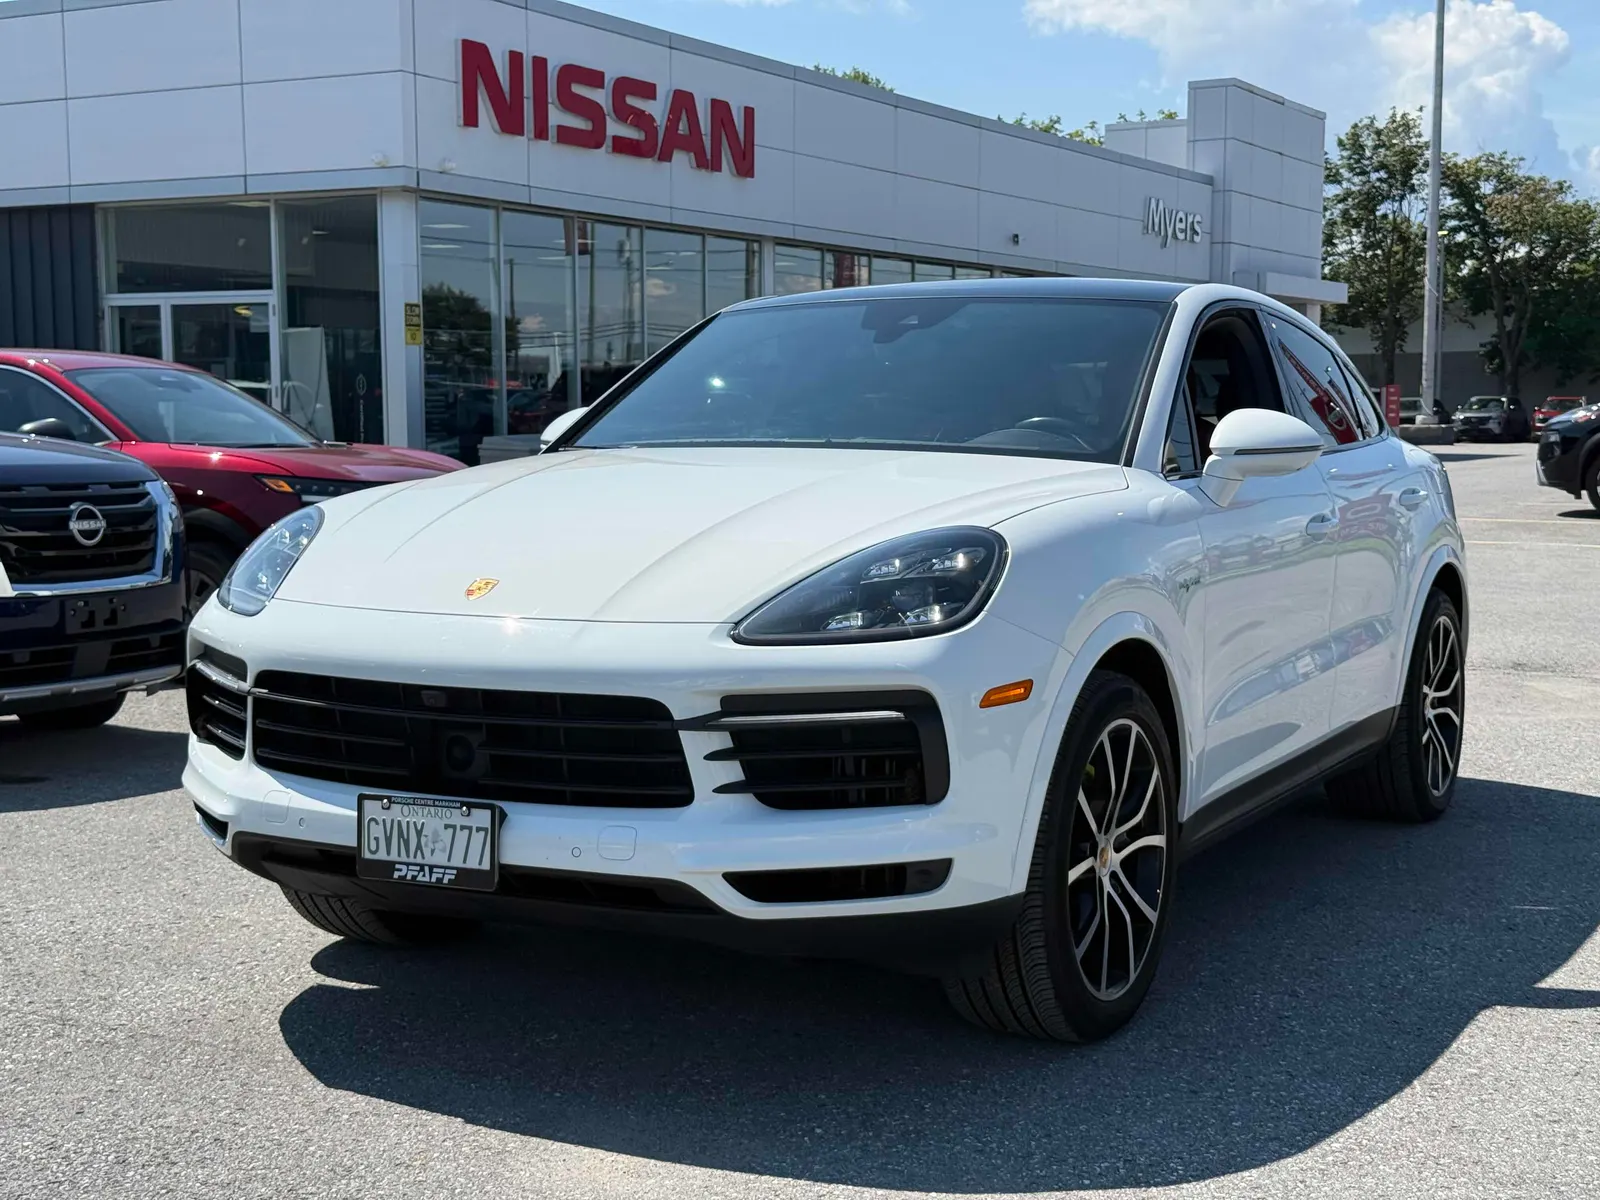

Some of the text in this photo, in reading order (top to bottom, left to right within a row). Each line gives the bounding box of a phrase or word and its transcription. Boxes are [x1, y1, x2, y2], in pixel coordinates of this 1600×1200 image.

[459, 38, 755, 179] NISSAN
[1147, 197, 1202, 248] Myers
[69, 520, 107, 530] NISSAN
[391, 796, 461, 808] PORSCHE CENTRE MARKHAM
[366, 816, 489, 866] GVNX 777
[393, 864, 458, 884] PFAFF
